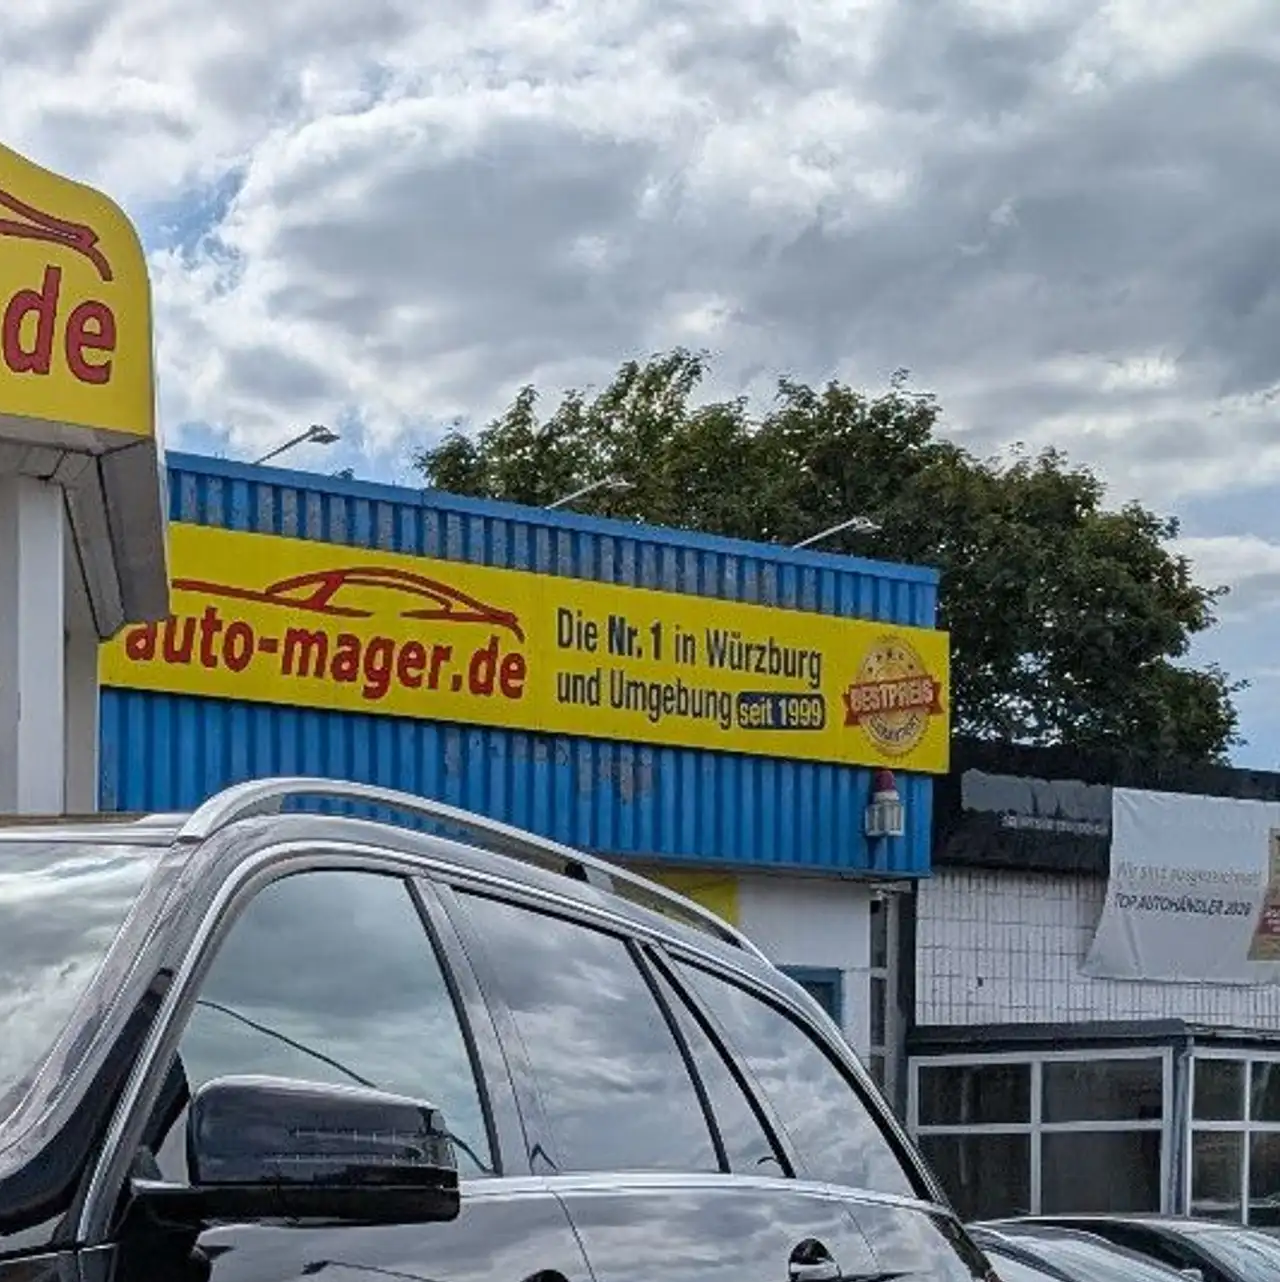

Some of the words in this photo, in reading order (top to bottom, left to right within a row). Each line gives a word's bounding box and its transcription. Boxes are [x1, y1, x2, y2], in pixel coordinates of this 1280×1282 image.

[125, 606, 526, 698] auto-mager.de
[557, 607, 597, 653] Die
[675, 624, 696, 666] in
[706, 627, 822, 689] Würzburg
[557, 668, 601, 707] und
[610, 669, 732, 730] Umgebung
[740, 697, 774, 726] seit
[778, 699, 823, 727] 1999
